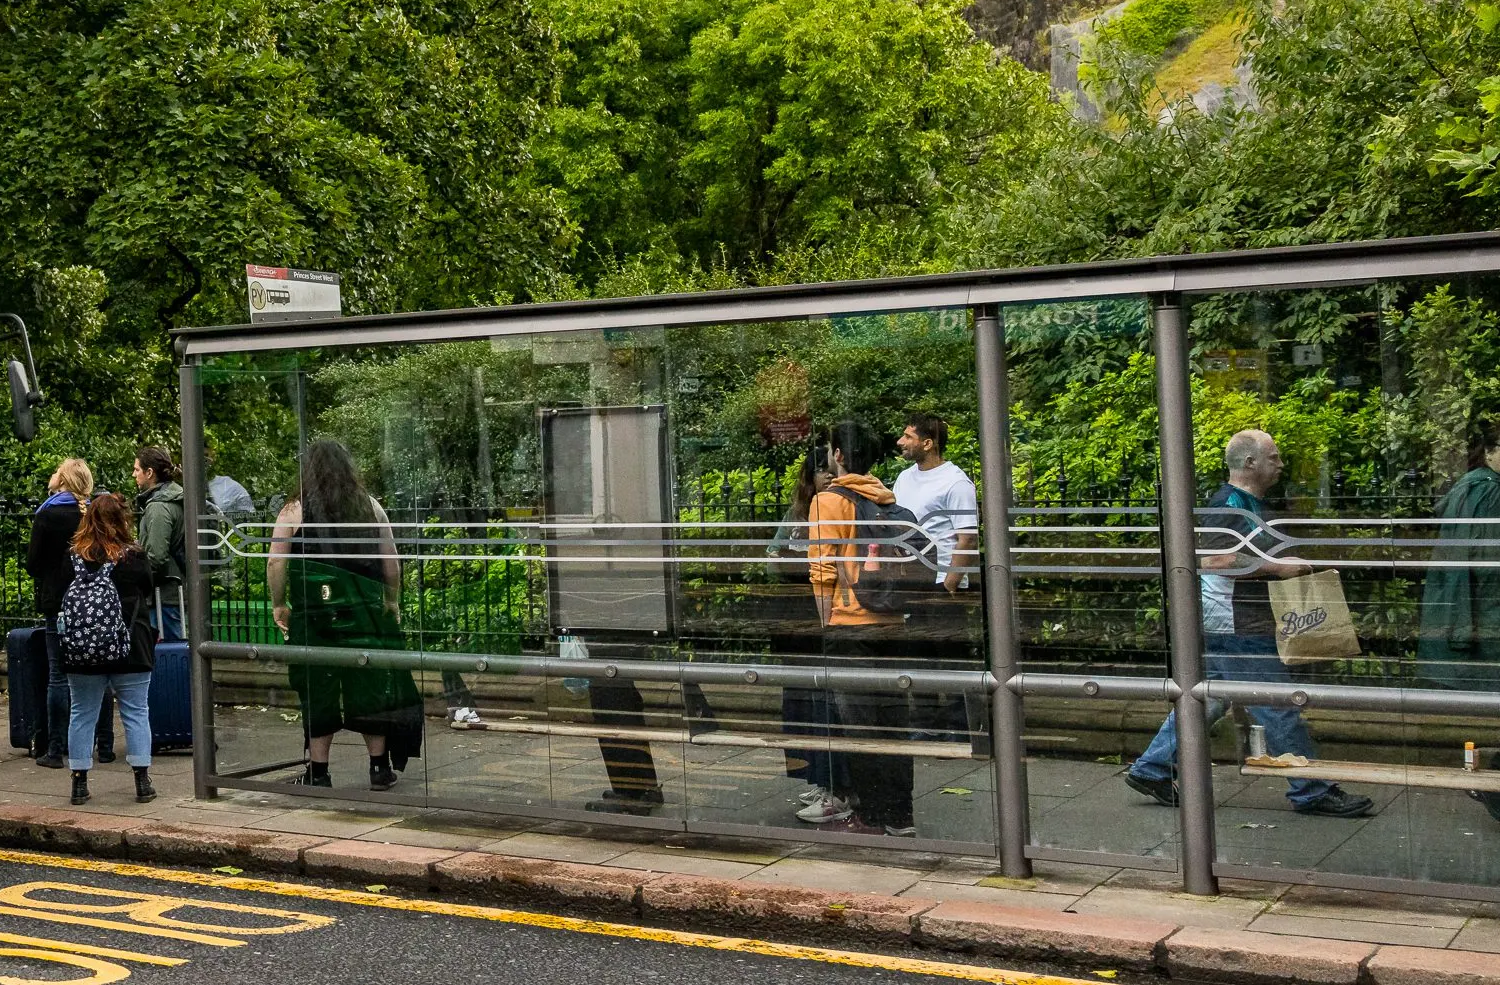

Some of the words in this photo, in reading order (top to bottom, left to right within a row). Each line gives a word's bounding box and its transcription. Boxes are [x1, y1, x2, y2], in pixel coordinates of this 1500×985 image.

[293, 271, 310, 280] Princes
[310, 273, 322, 281] Street
[323, 274, 334, 282] West
[251, 287, 264, 304] PY
[1280, 606, 1327, 636] Boots
